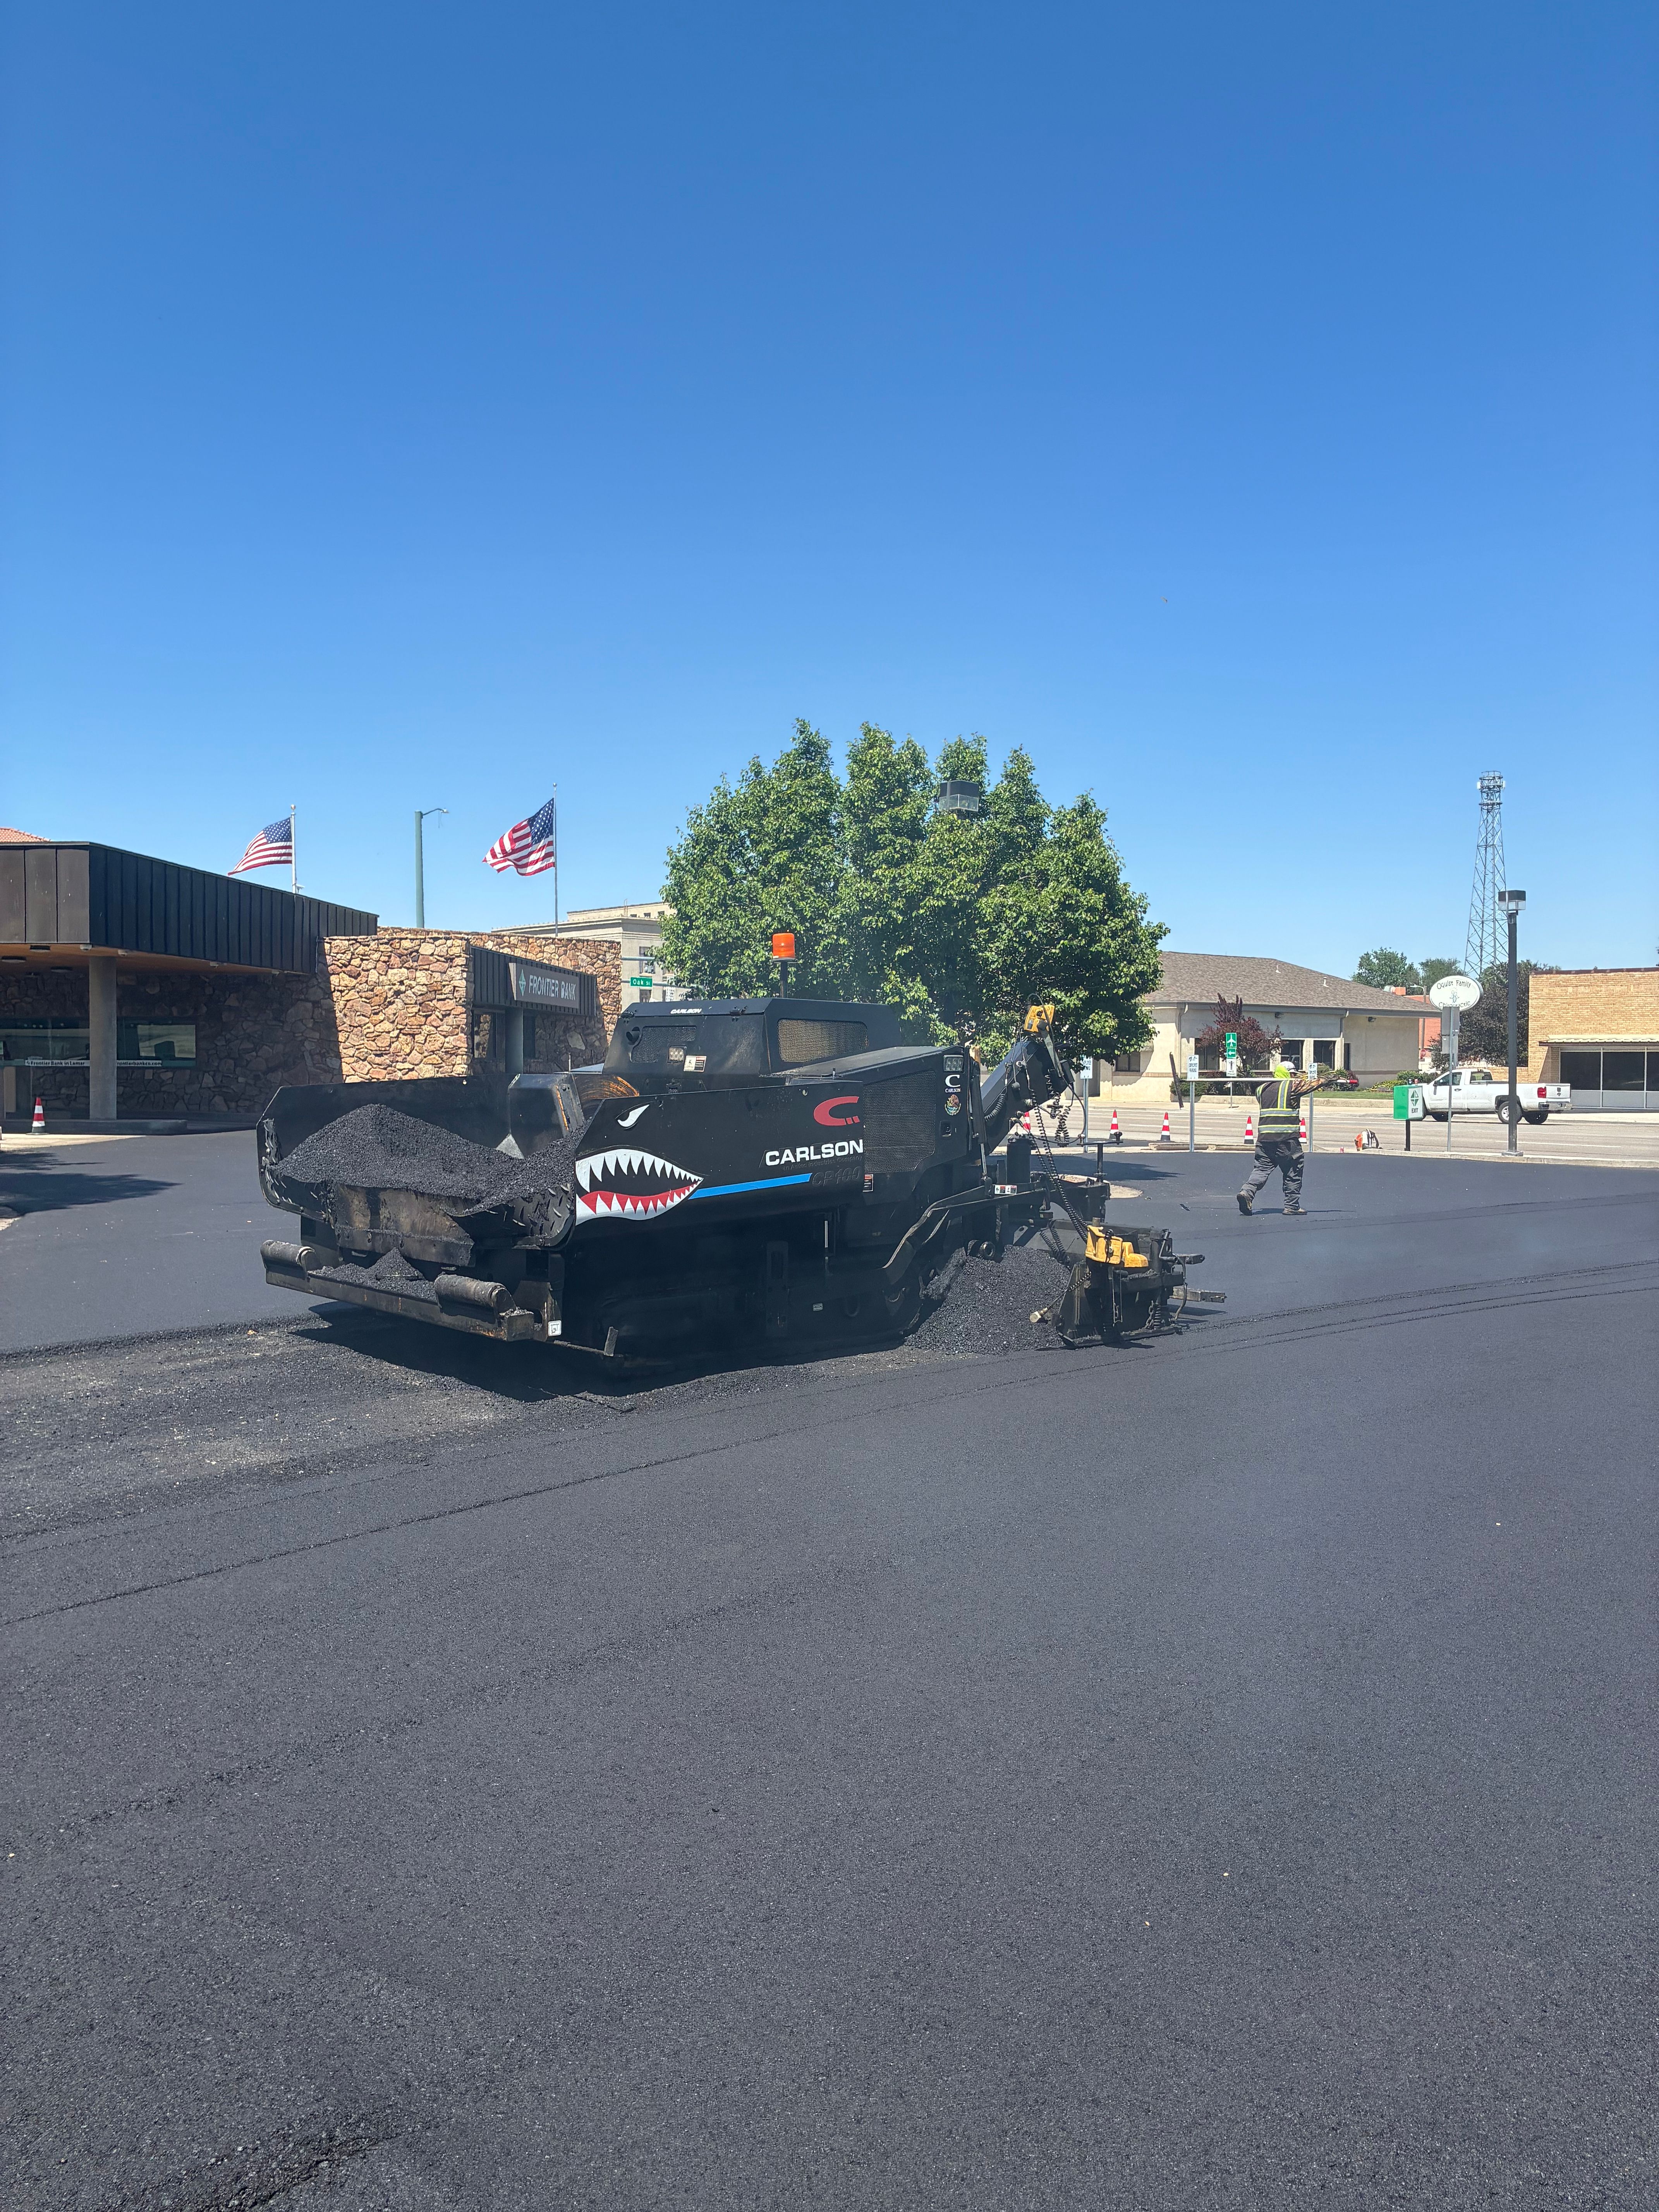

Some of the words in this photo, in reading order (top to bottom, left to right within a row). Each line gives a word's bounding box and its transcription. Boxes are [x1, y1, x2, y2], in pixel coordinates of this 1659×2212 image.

[529, 975, 559, 998] FRONTIER
[561, 981, 576, 1000] BANK
[1437, 981, 1453, 989] Oquist
[765, 1139, 864, 1166] CARLSON
